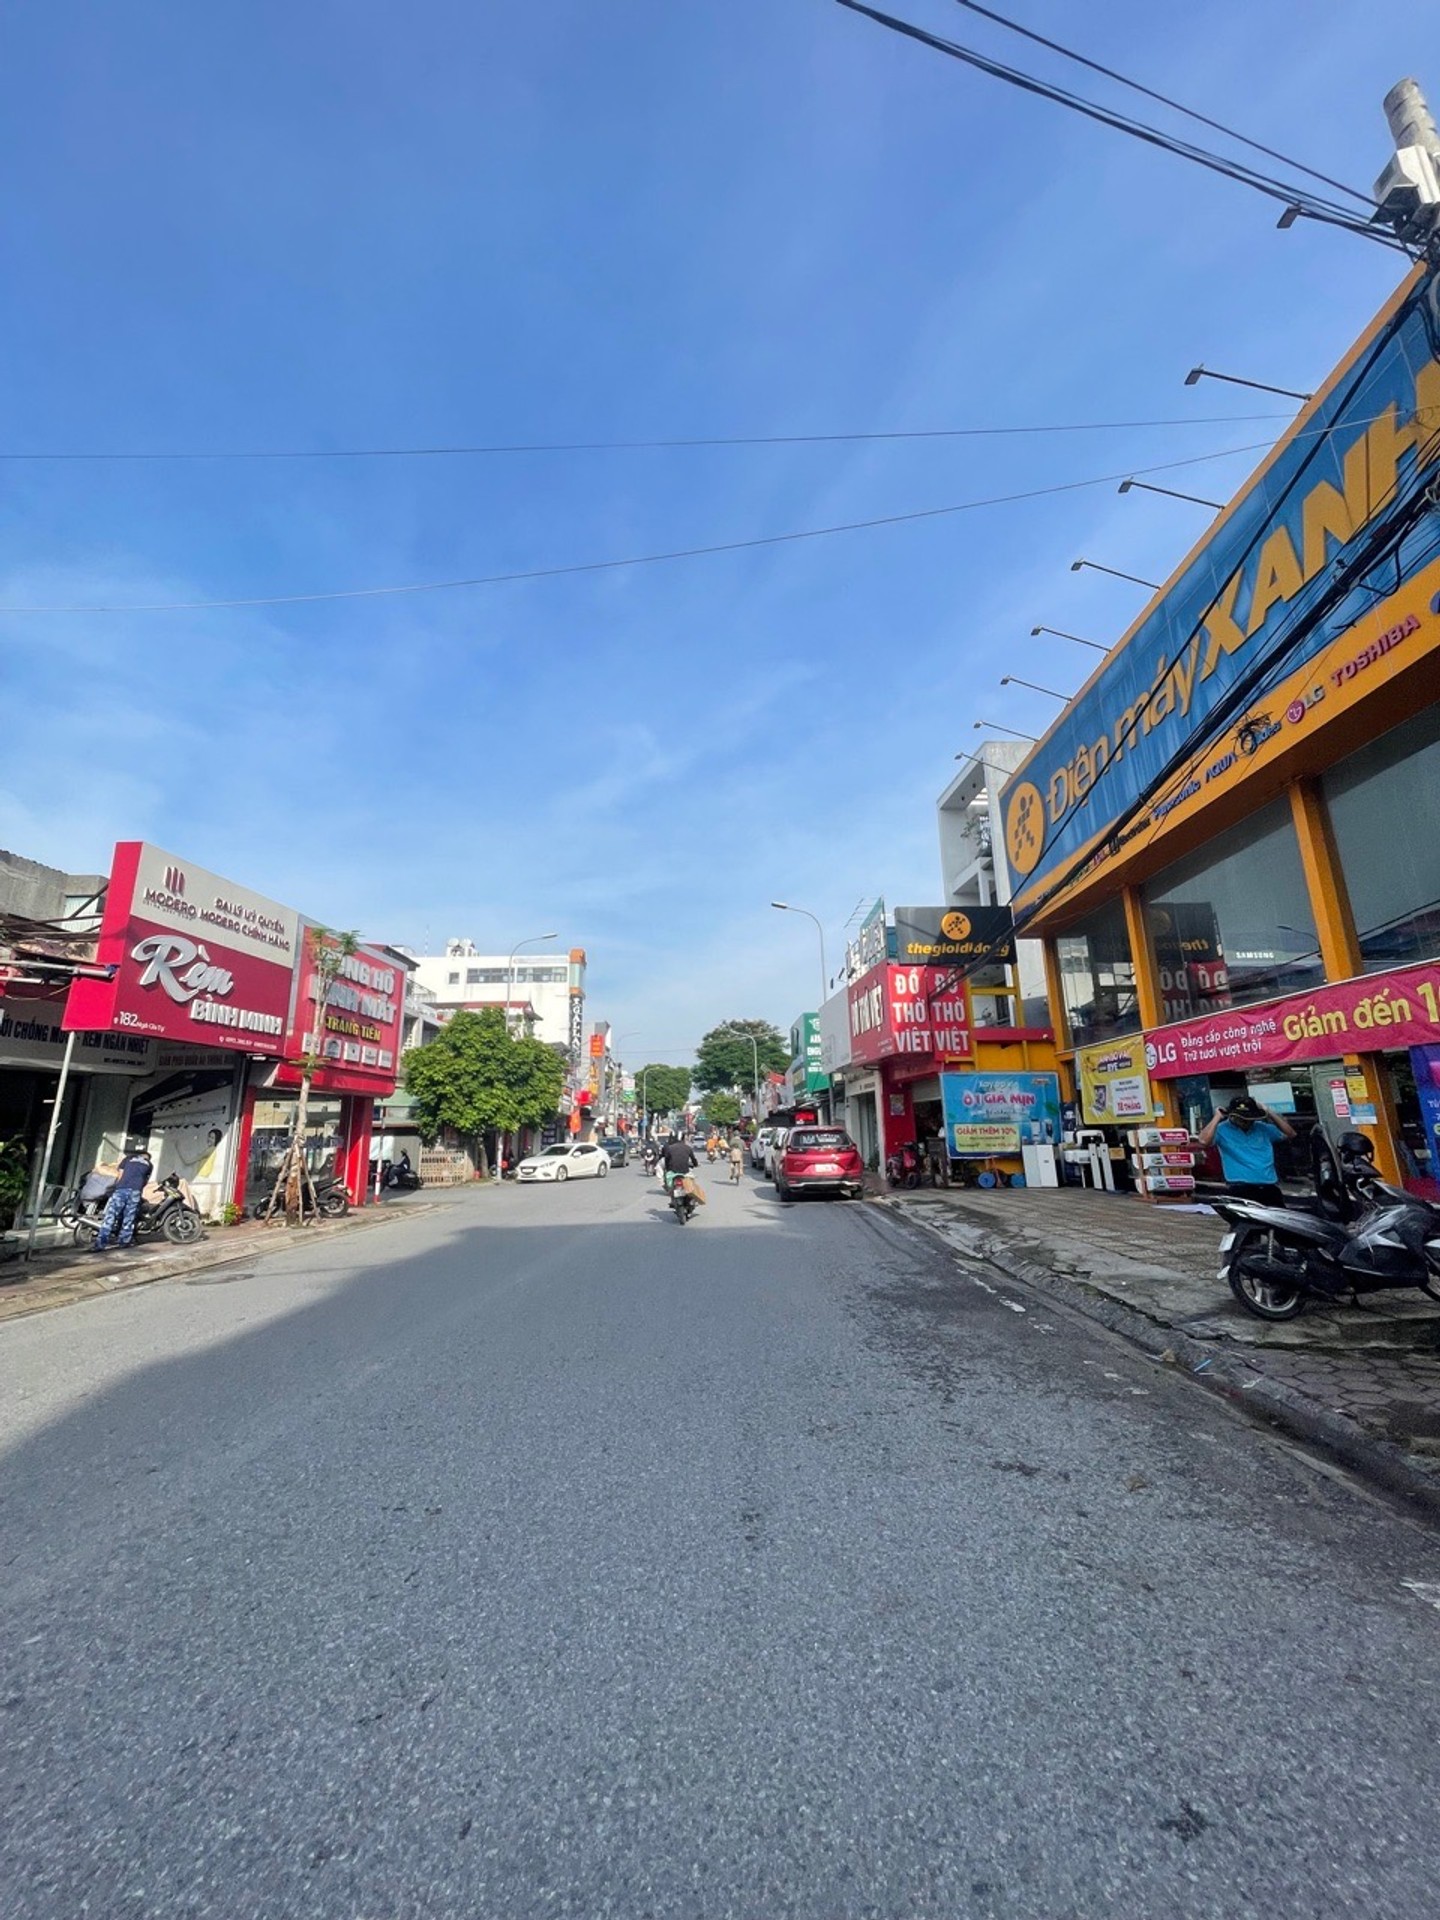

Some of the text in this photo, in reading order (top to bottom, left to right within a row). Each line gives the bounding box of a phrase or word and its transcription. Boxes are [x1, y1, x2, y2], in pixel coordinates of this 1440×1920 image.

[1331, 613, 1421, 688] TOSHIBA
[1303, 684, 1326, 710] LG
[1046, 734, 1109, 824] Điện
[1114, 634, 1200, 763] máy
[144, 887, 197, 917] MODERO
[1235, 951, 1275, 959] SAMSUNG
[131, 935, 234, 1003] Rèm
[894, 967, 920, 994] ĐỒ
[119, 1011, 138, 1026] 182
[190, 994, 283, 1035] BÌNH MINH
[892, 997, 926, 1023] THỜ
[932, 999, 966, 1023] THỜ
[1283, 981, 1440, 1041] Giảm đến 1
[934, 1027, 969, 1054] VIỆT
[1205, 1028, 1221, 1046] cấp
[1222, 1025, 1247, 1041] công
[1250, 1018, 1277, 1035] nghệ
[1158, 1042, 1177, 1063] LG
[1219, 1042, 1241, 1058] vượt
[1243, 1039, 1262, 1055] trội
